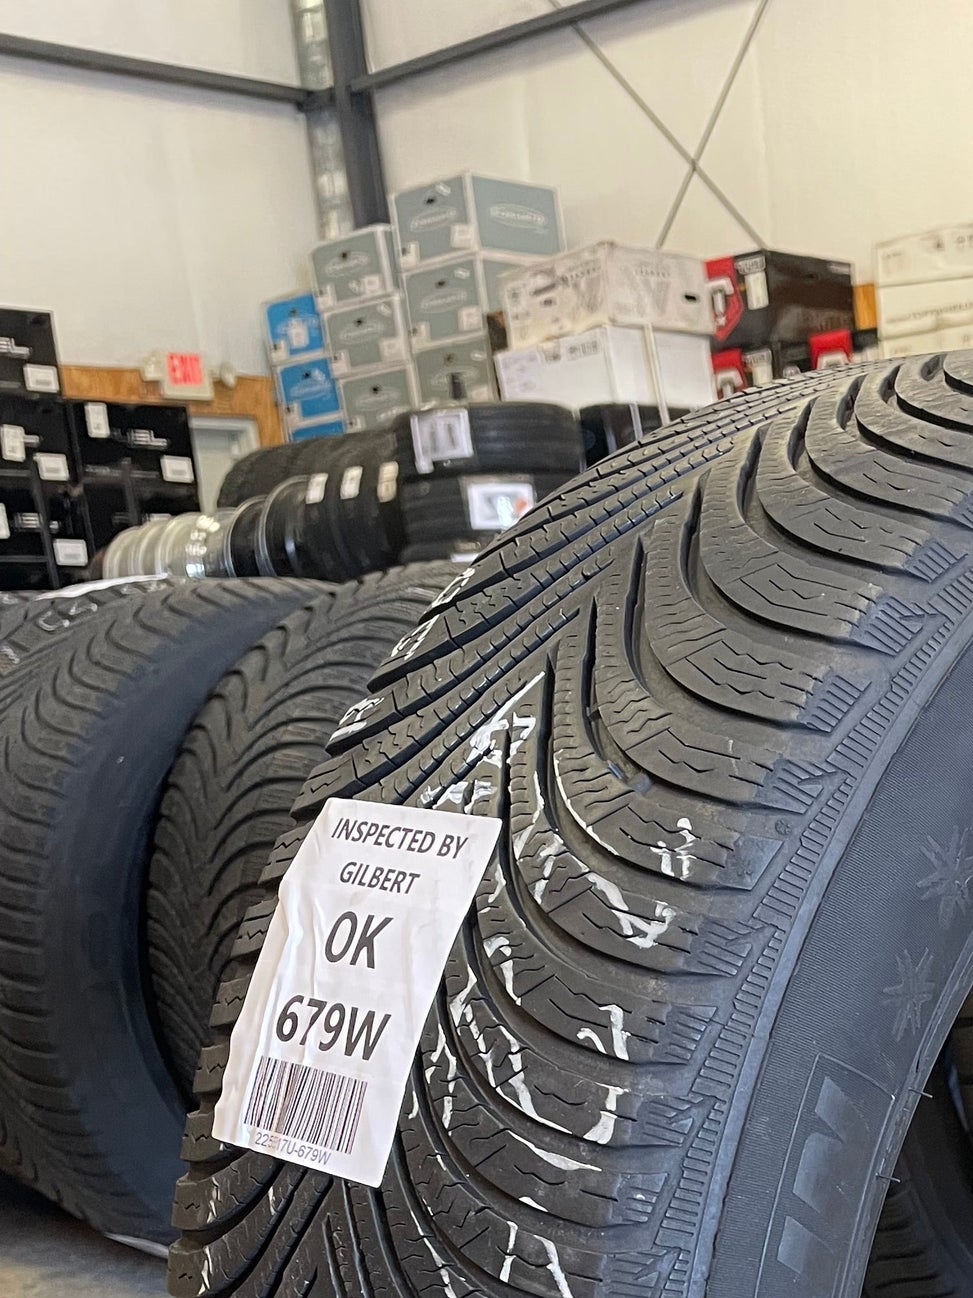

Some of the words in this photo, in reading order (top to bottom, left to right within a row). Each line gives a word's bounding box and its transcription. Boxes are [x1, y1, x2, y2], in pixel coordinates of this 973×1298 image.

[331, 817, 436, 854] INSPECTED
[436, 834, 469, 859] BY
[339, 861, 421, 894] GILBERT
[324, 910, 394, 969] OK
[275, 994, 392, 1062] 679W
